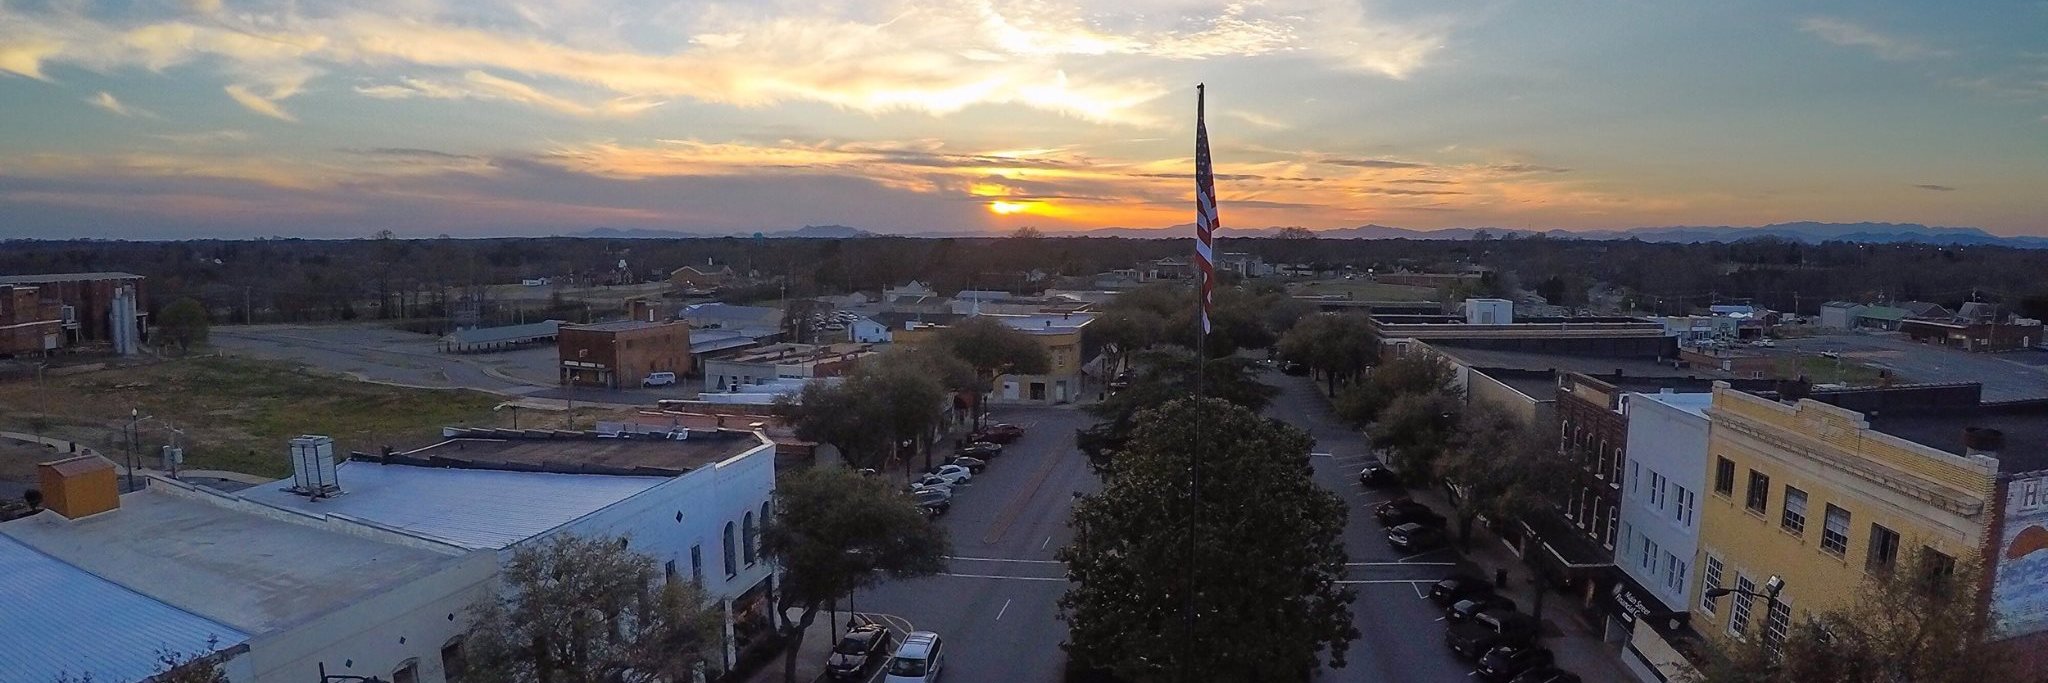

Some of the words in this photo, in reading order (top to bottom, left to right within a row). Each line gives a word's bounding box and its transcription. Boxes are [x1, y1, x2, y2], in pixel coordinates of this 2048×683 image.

[1615, 593, 1636, 614] Financial
[1625, 591, 1637, 604] Main
[1635, 600, 1650, 615] Street
